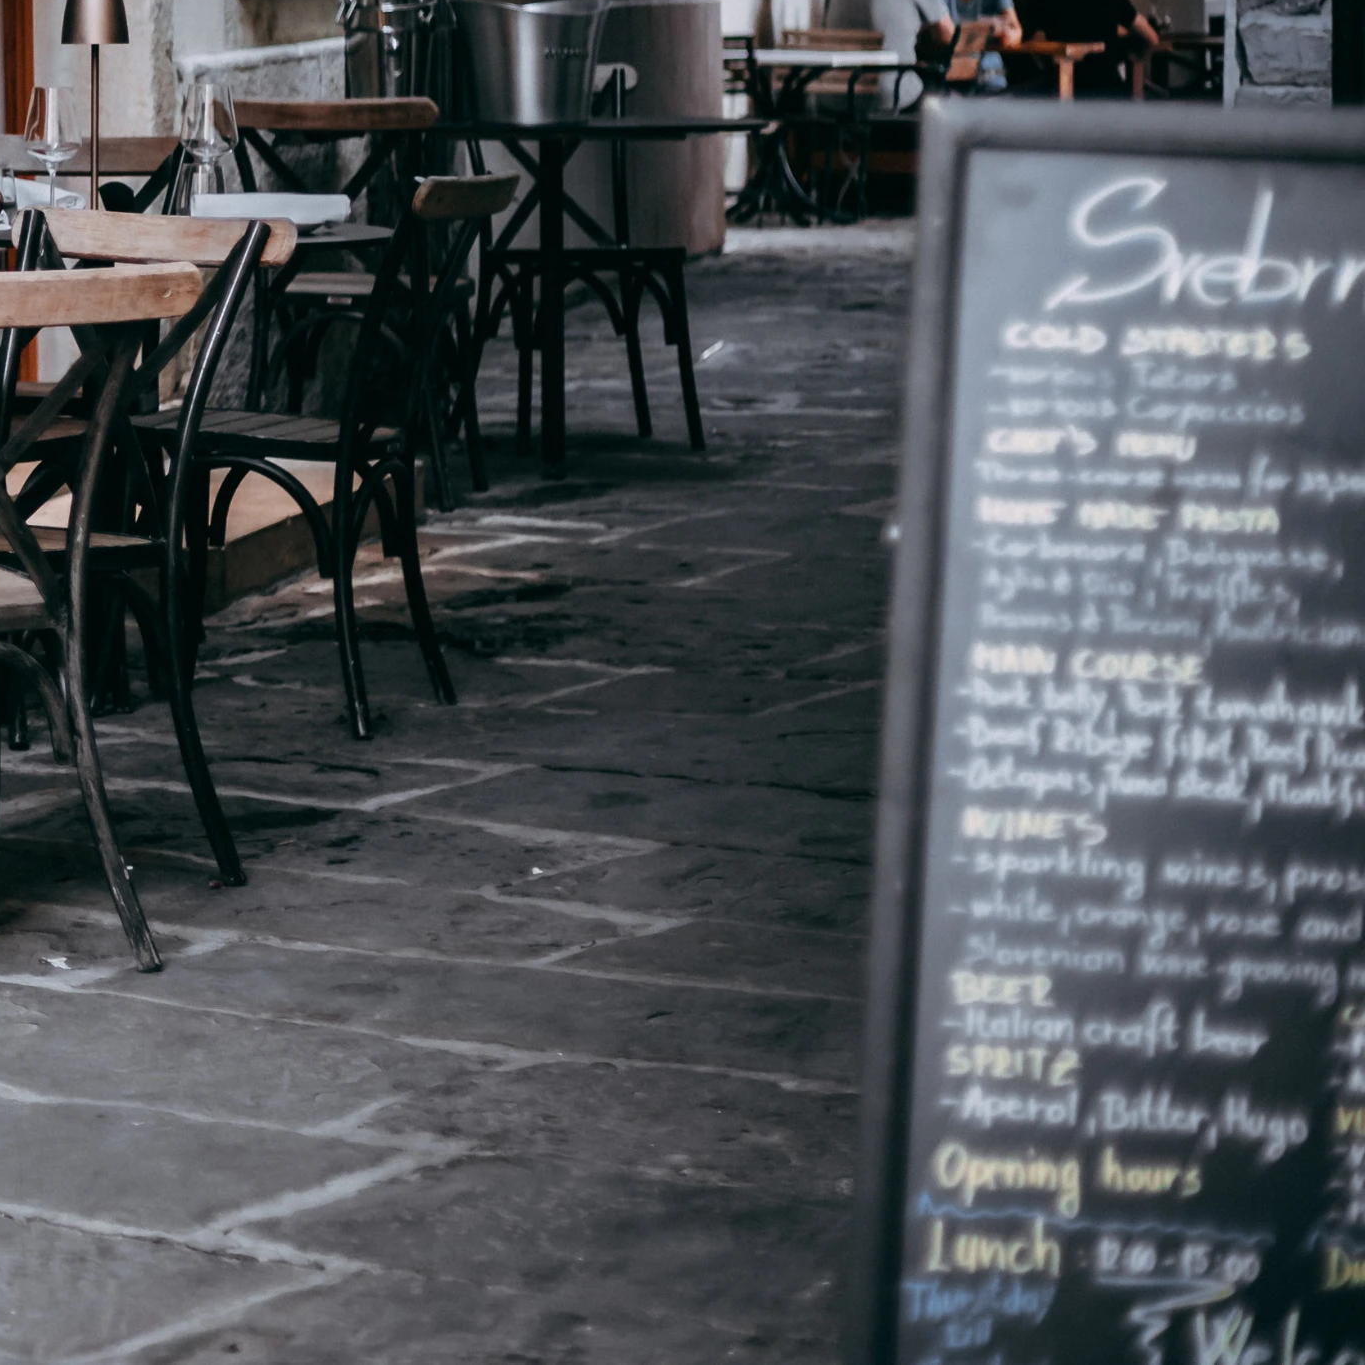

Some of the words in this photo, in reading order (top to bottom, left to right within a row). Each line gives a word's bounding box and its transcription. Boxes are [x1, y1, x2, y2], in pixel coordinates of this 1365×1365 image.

[1002, 322, 1108, 354] COLD
[1180, 501, 1282, 534] PASTA
[1071, 648, 1206, 686] COURSE
[963, 807, 1108, 846] WINES
[1299, 901, 1364, 942] and
[951, 970, 1054, 1008] BEER
[1082, 997, 1179, 1058] craft
[1190, 1007, 1270, 1058] beer
[945, 1043, 1083, 1088] SPRITZ
[1222, 1093, 1310, 1166] Hugo
[1099, 1145, 1204, 1199] hours
[927, 1216, 1062, 1278] Lunch
